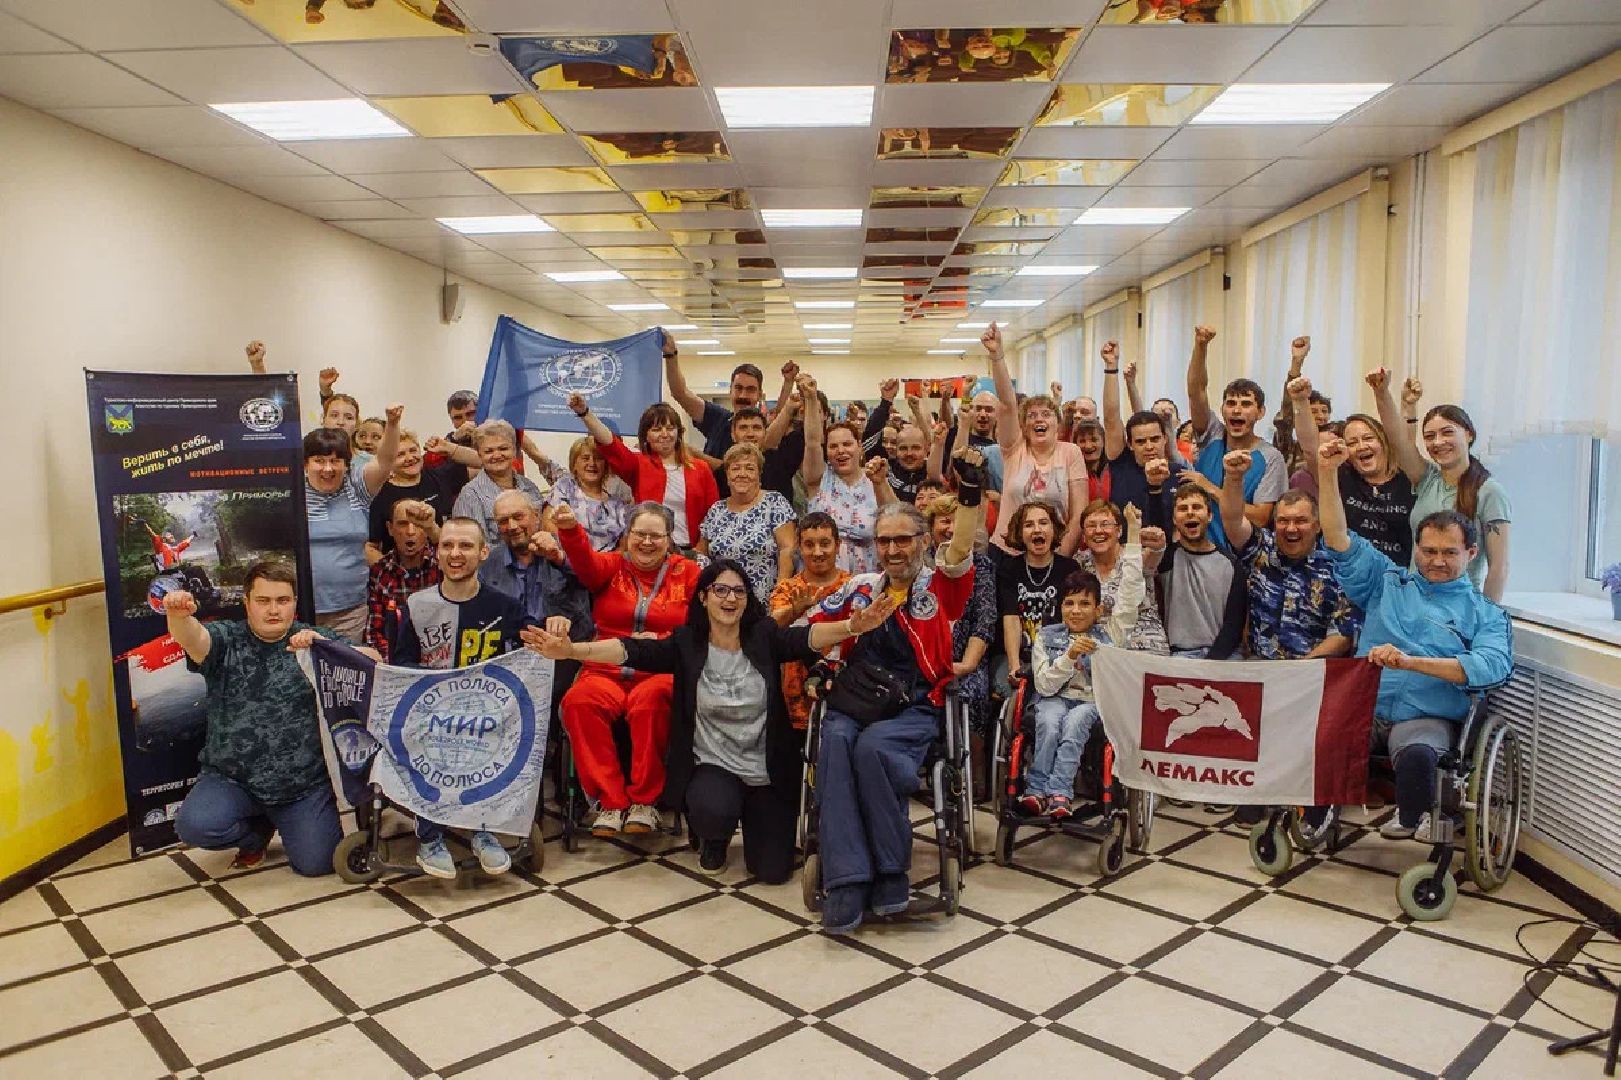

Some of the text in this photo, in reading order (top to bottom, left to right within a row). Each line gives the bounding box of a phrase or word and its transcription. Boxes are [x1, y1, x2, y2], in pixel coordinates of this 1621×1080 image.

[122, 448, 169, 469] Верить
[181, 434, 211, 451] себя,
[131, 439, 224, 478] жить по мечте!
[320, 658, 332, 675] TH
[323, 691, 334, 709] TO
[423, 678, 510, 706] ОТ ПОЛЮСА
[428, 714, 497, 739] МИР
[412, 754, 505, 789] ДО ПОЛЮСА
[1140, 758, 1256, 787] ЛЕМАКС
